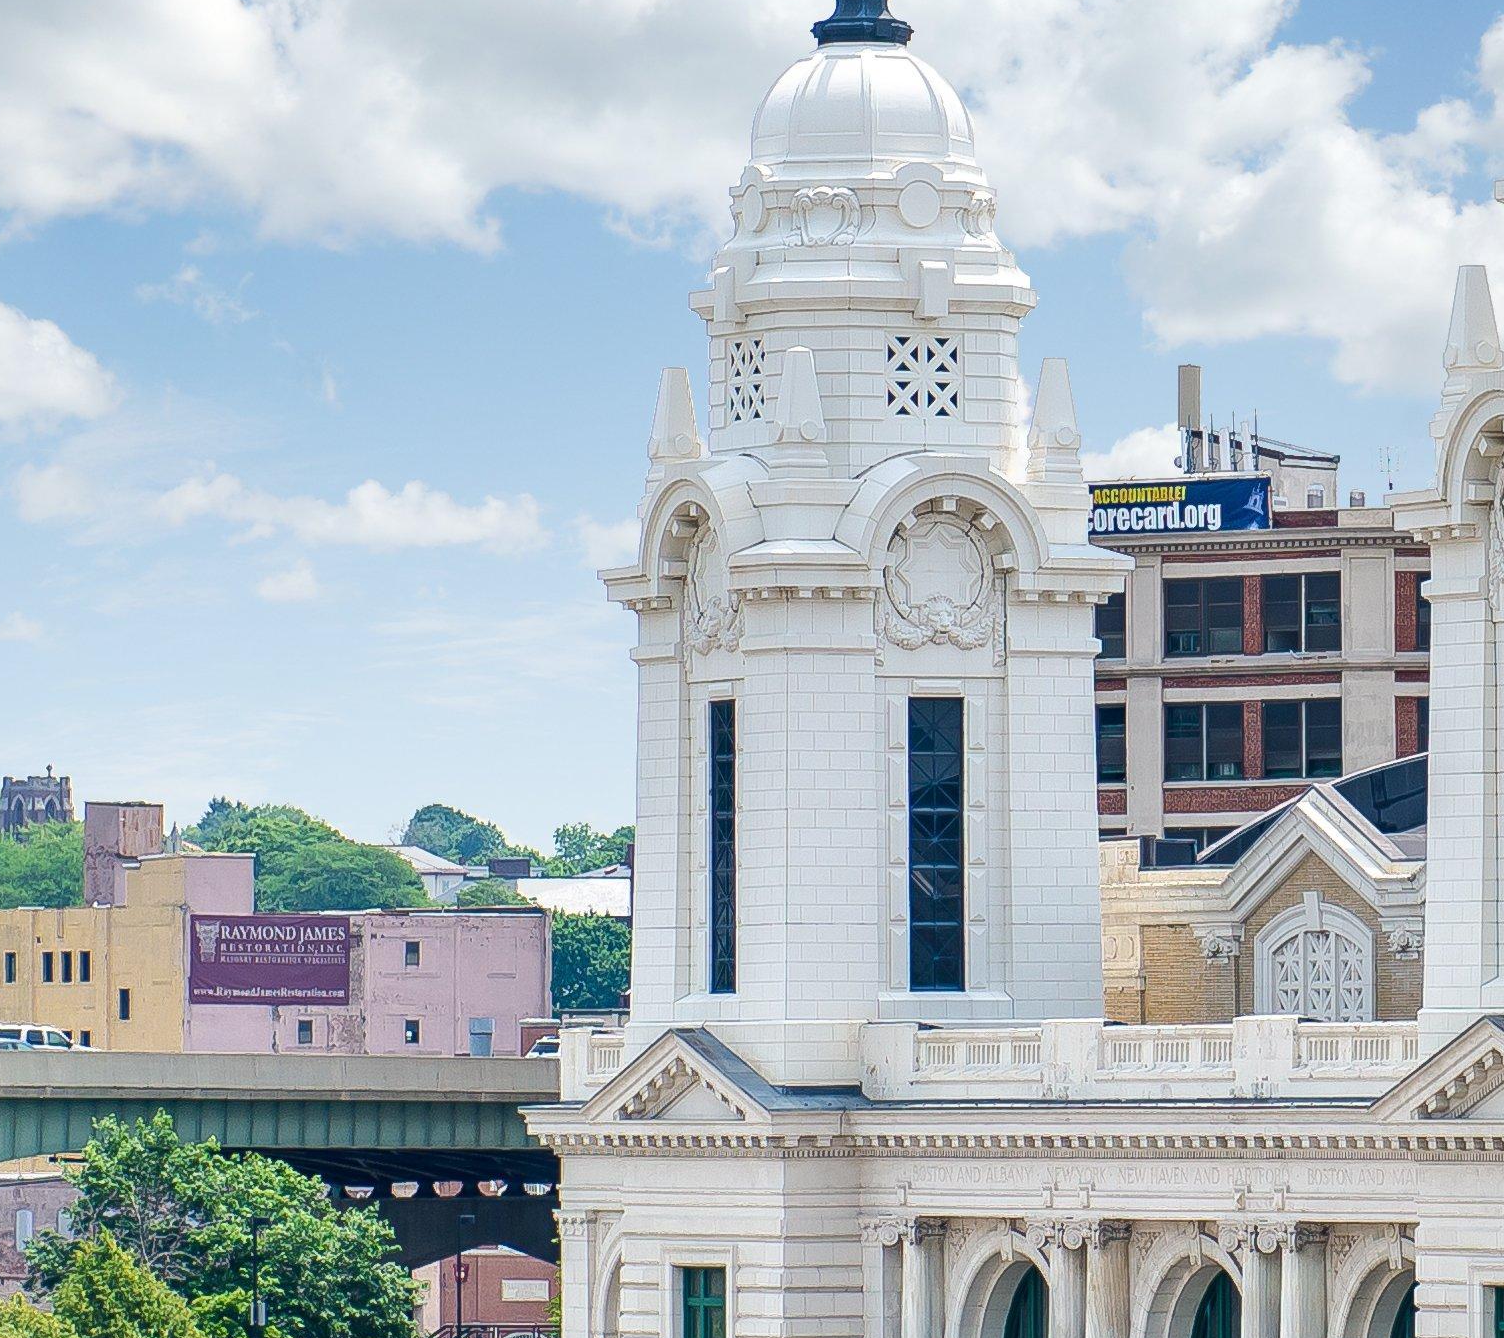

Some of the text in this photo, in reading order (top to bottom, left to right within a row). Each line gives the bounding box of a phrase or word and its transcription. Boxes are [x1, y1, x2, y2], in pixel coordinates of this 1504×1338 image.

[1093, 486, 1187, 504] ACCOUNTABLE!
[221, 926, 346, 943] RAYMOND JAMES
[194, 986, 345, 999] www.RaymondJamesRestoration.com
